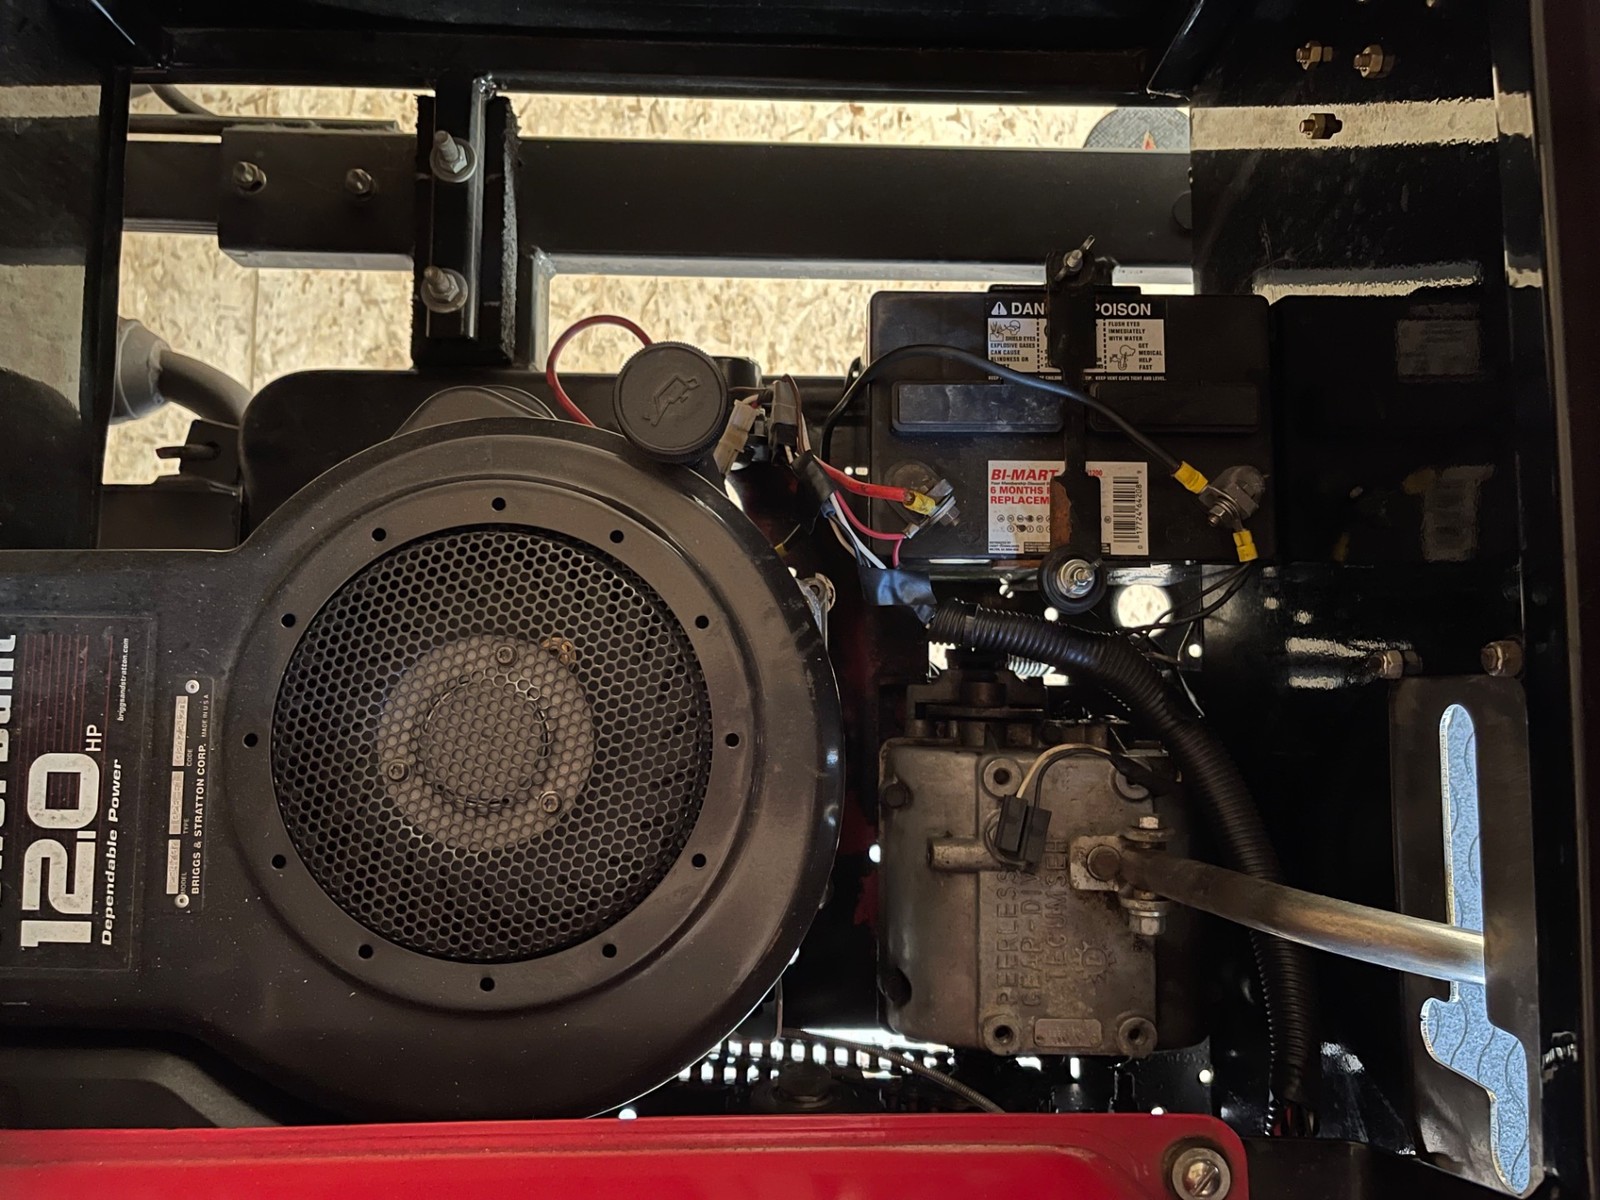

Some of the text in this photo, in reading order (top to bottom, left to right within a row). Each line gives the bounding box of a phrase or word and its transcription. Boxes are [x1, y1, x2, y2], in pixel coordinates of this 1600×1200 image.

[1011, 302, 1045, 315] DAN
[990, 486, 997, 494] 6
[999, 486, 1044, 494] MONTHS
[991, 469, 1059, 481] BI-MART
[990, 496, 1051, 505] REPLACEM
[117, 638, 129, 721] briggsandstratton.com
[85, 724, 102, 752] HP
[197, 743, 207, 775] CORP.
[194, 779, 205, 837] STRATTON
[101, 759, 121, 945] Dependable Power
[193, 841, 202, 849] &
[191, 852, 201, 894] BRIGGS
[1045, 839, 1068, 979] TECUMSEH
[996, 869, 1018, 1006] PEERLESS
